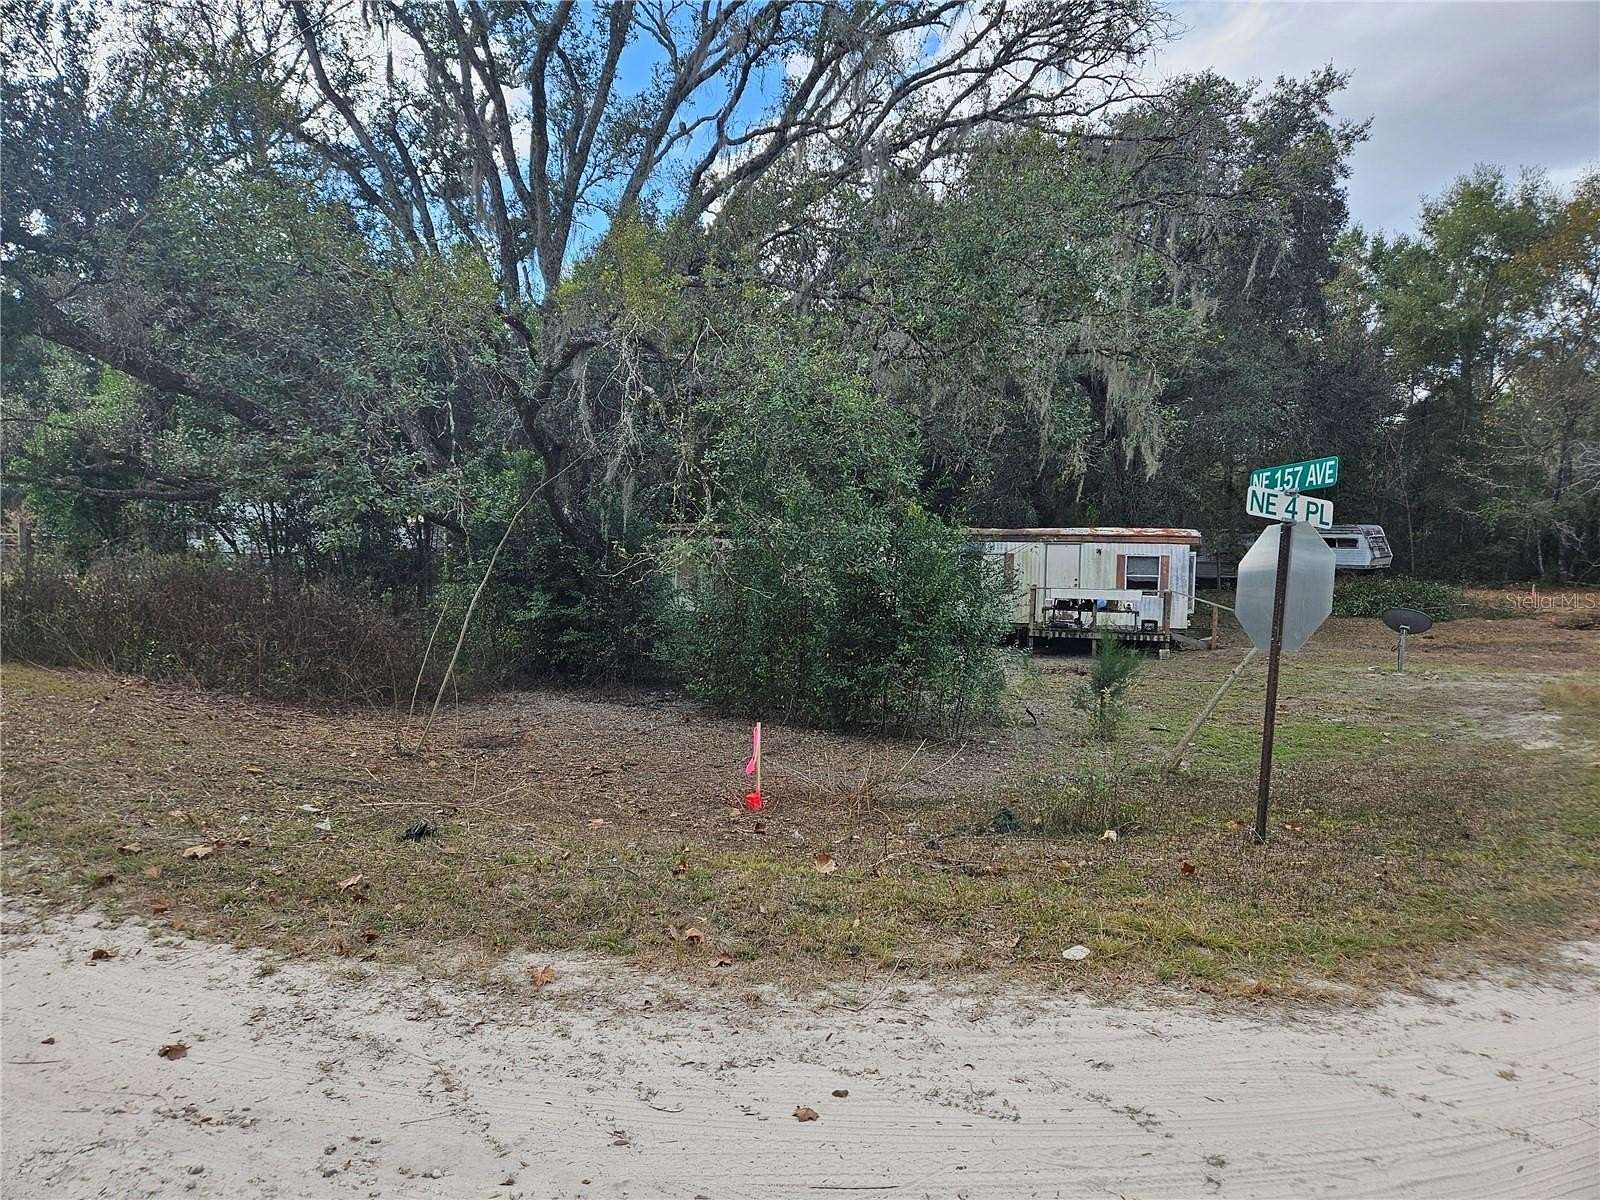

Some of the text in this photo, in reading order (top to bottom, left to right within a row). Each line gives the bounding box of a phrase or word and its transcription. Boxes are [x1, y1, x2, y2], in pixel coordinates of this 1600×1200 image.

[1274, 466, 1303, 491] 157
[1305, 460, 1335, 487] AVE
[1250, 490, 1330, 526] NE 4 PL
